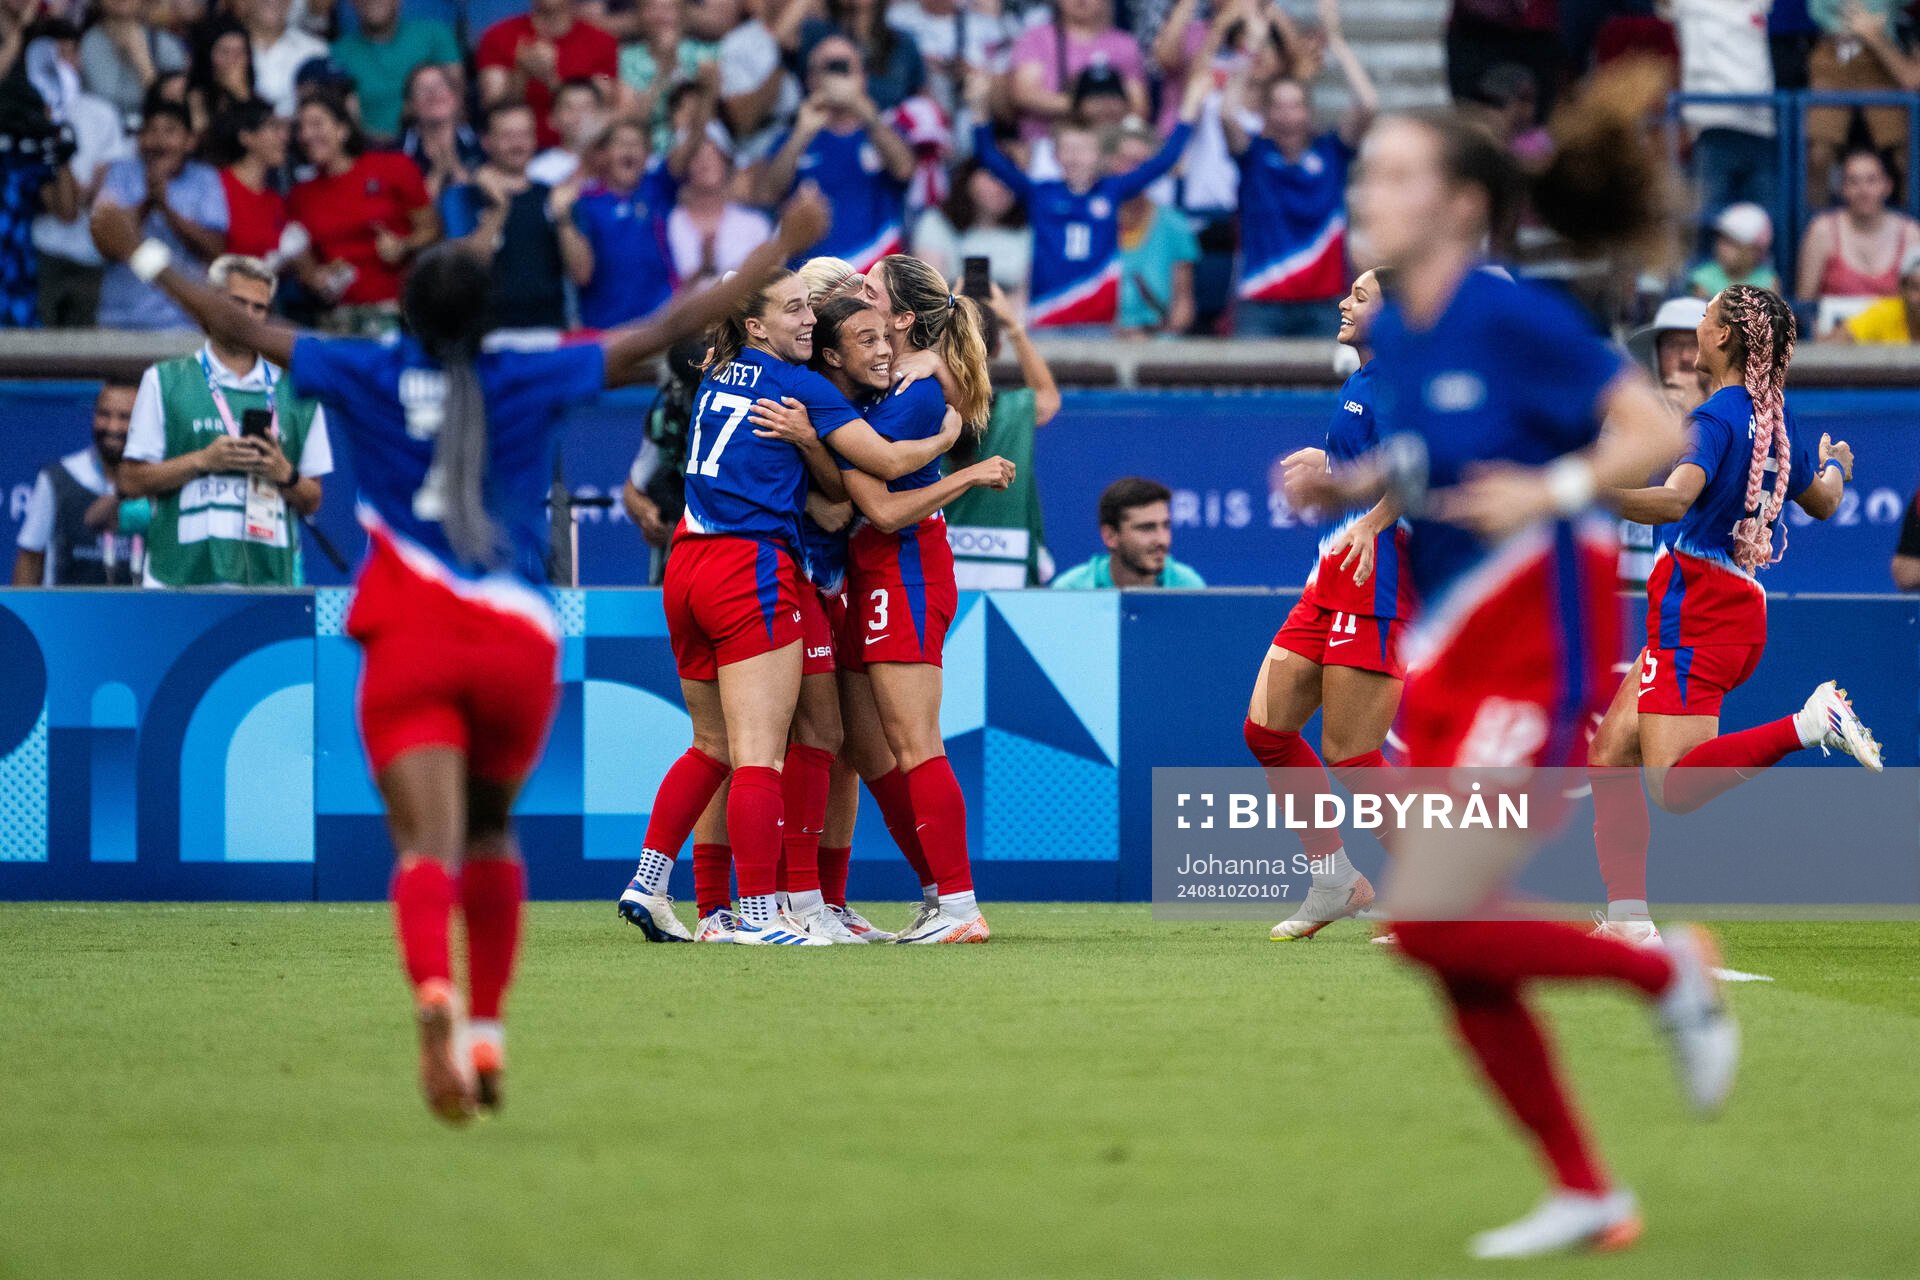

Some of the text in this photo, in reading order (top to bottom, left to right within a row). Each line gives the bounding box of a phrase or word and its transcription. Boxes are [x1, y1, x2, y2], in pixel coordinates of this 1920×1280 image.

[712, 361, 763, 388] OFFEY
[1343, 399, 1363, 416] USA
[686, 390, 752, 477] 17
[868, 588, 889, 631] 3
[807, 646, 832, 658] USA
